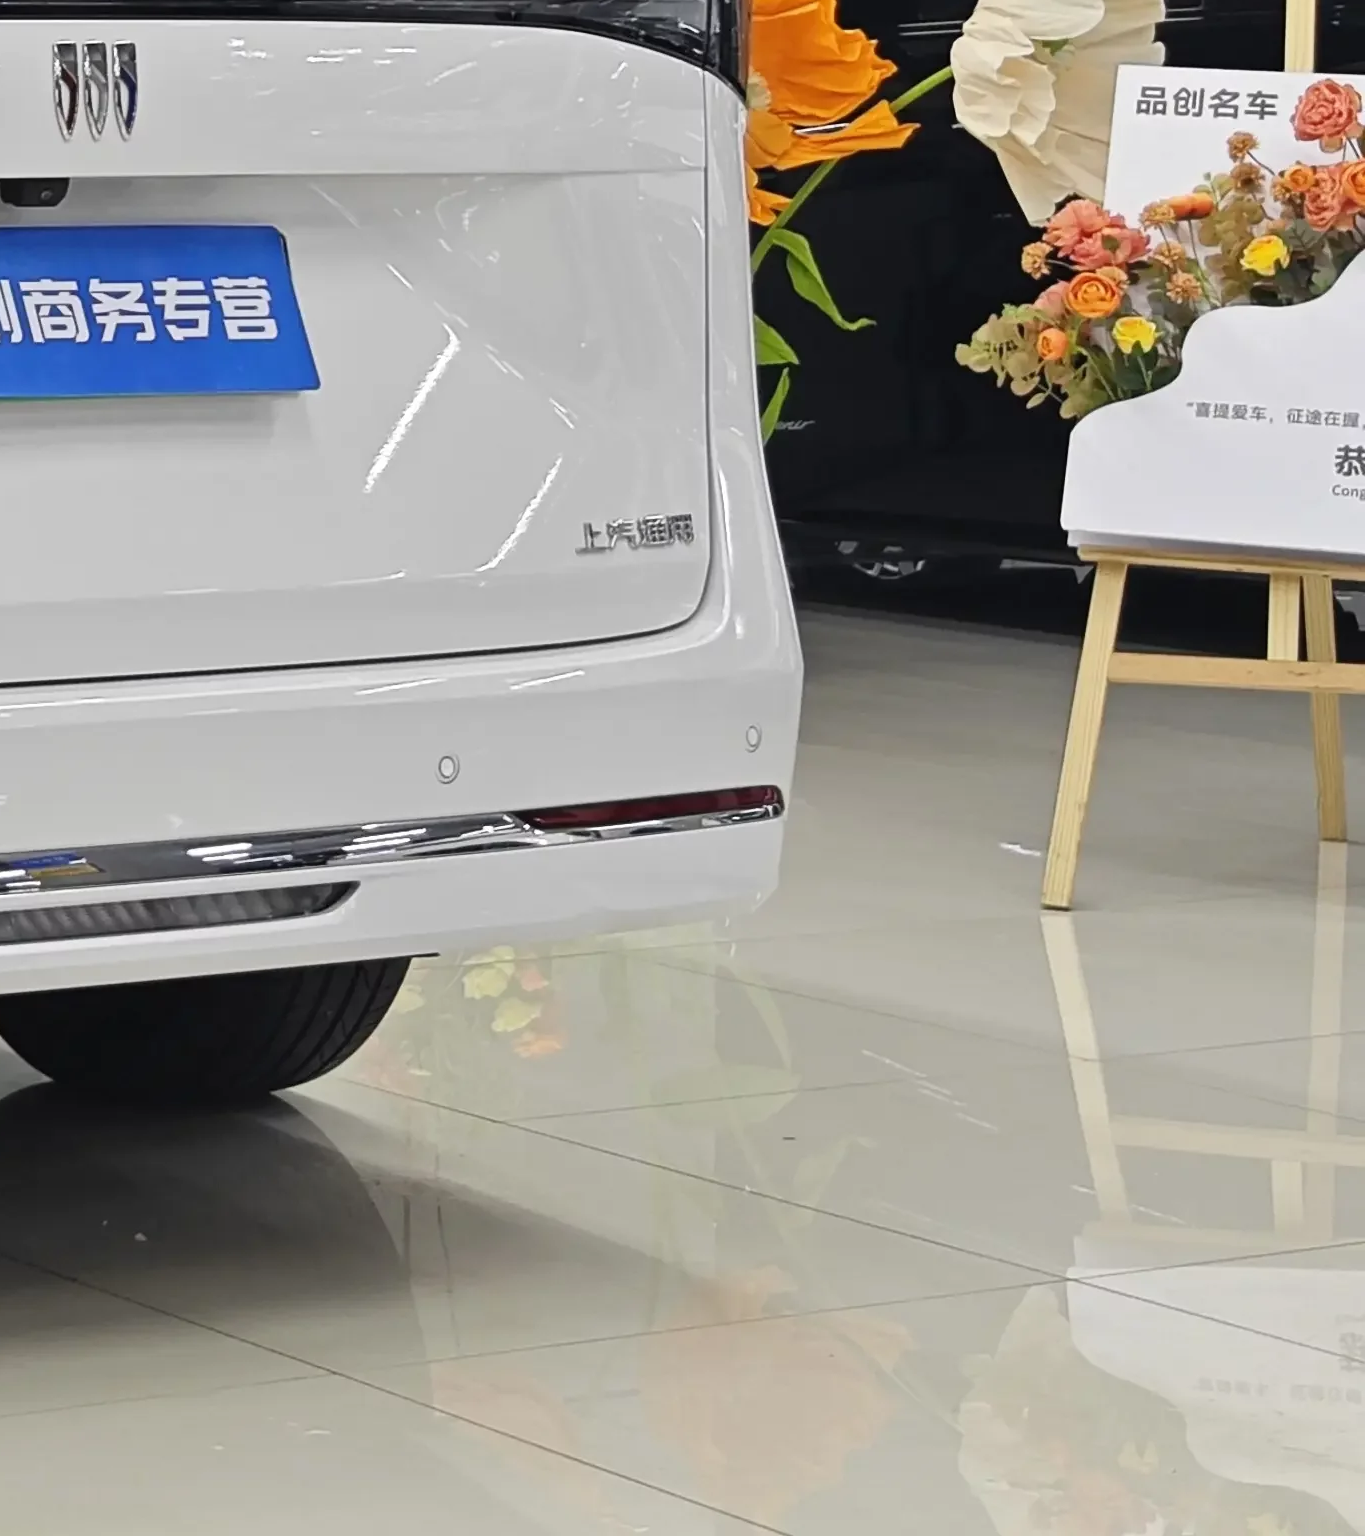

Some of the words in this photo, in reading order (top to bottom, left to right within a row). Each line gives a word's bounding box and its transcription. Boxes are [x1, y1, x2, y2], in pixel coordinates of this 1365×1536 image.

[1135, 85, 1279, 121] 品创名车
[574, 513, 696, 557] 上汽通用
